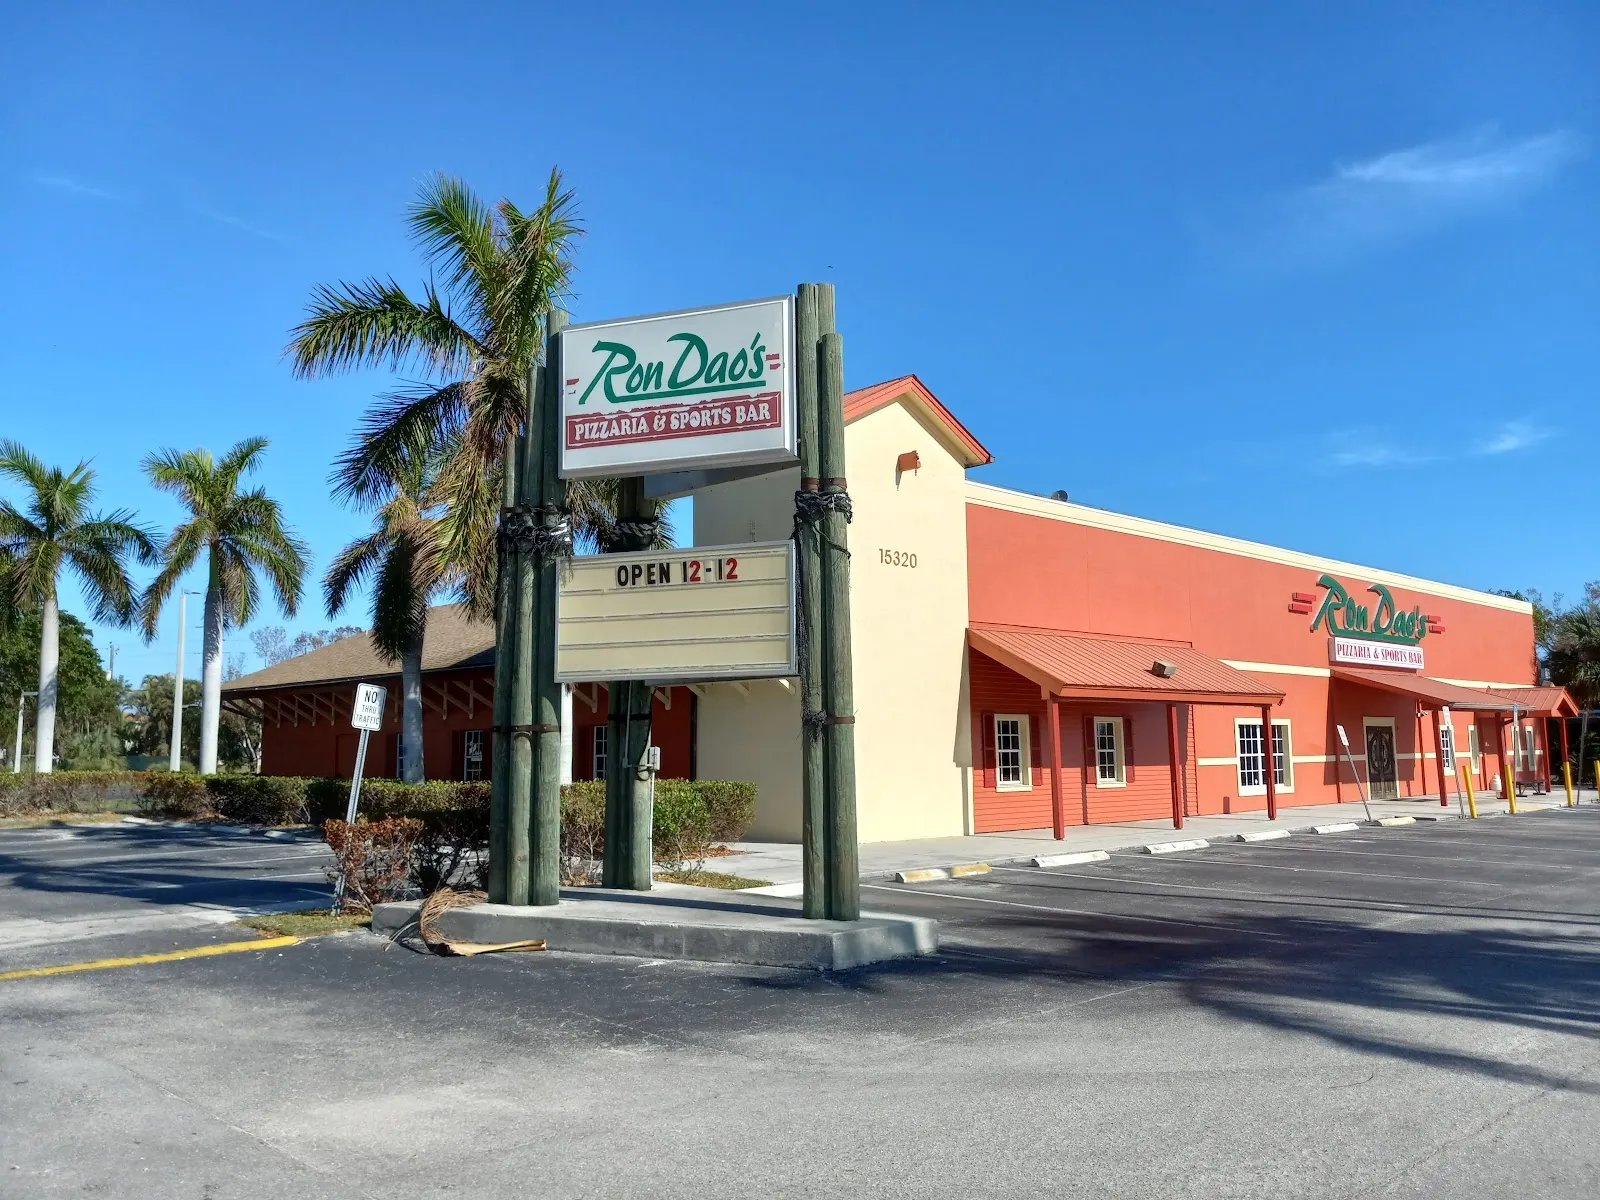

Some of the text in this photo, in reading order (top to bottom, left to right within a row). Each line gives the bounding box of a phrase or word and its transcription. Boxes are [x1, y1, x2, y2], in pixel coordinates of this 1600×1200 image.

[579, 332, 766, 405] Ron Dao's
[574, 402, 771, 441] PIZZARIA & SPORTS BAR
[878, 548, 917, 569] 15320
[617, 557, 738, 587] OPEN 12-12
[1310, 574, 1428, 640] Ron Dao's
[1336, 643, 1423, 665] PIZZARIA & SPORTS BAR
[364, 690, 378, 703] NO
[356, 714, 380, 725] TRAFFIC
[362, 705, 377, 714] THRU
